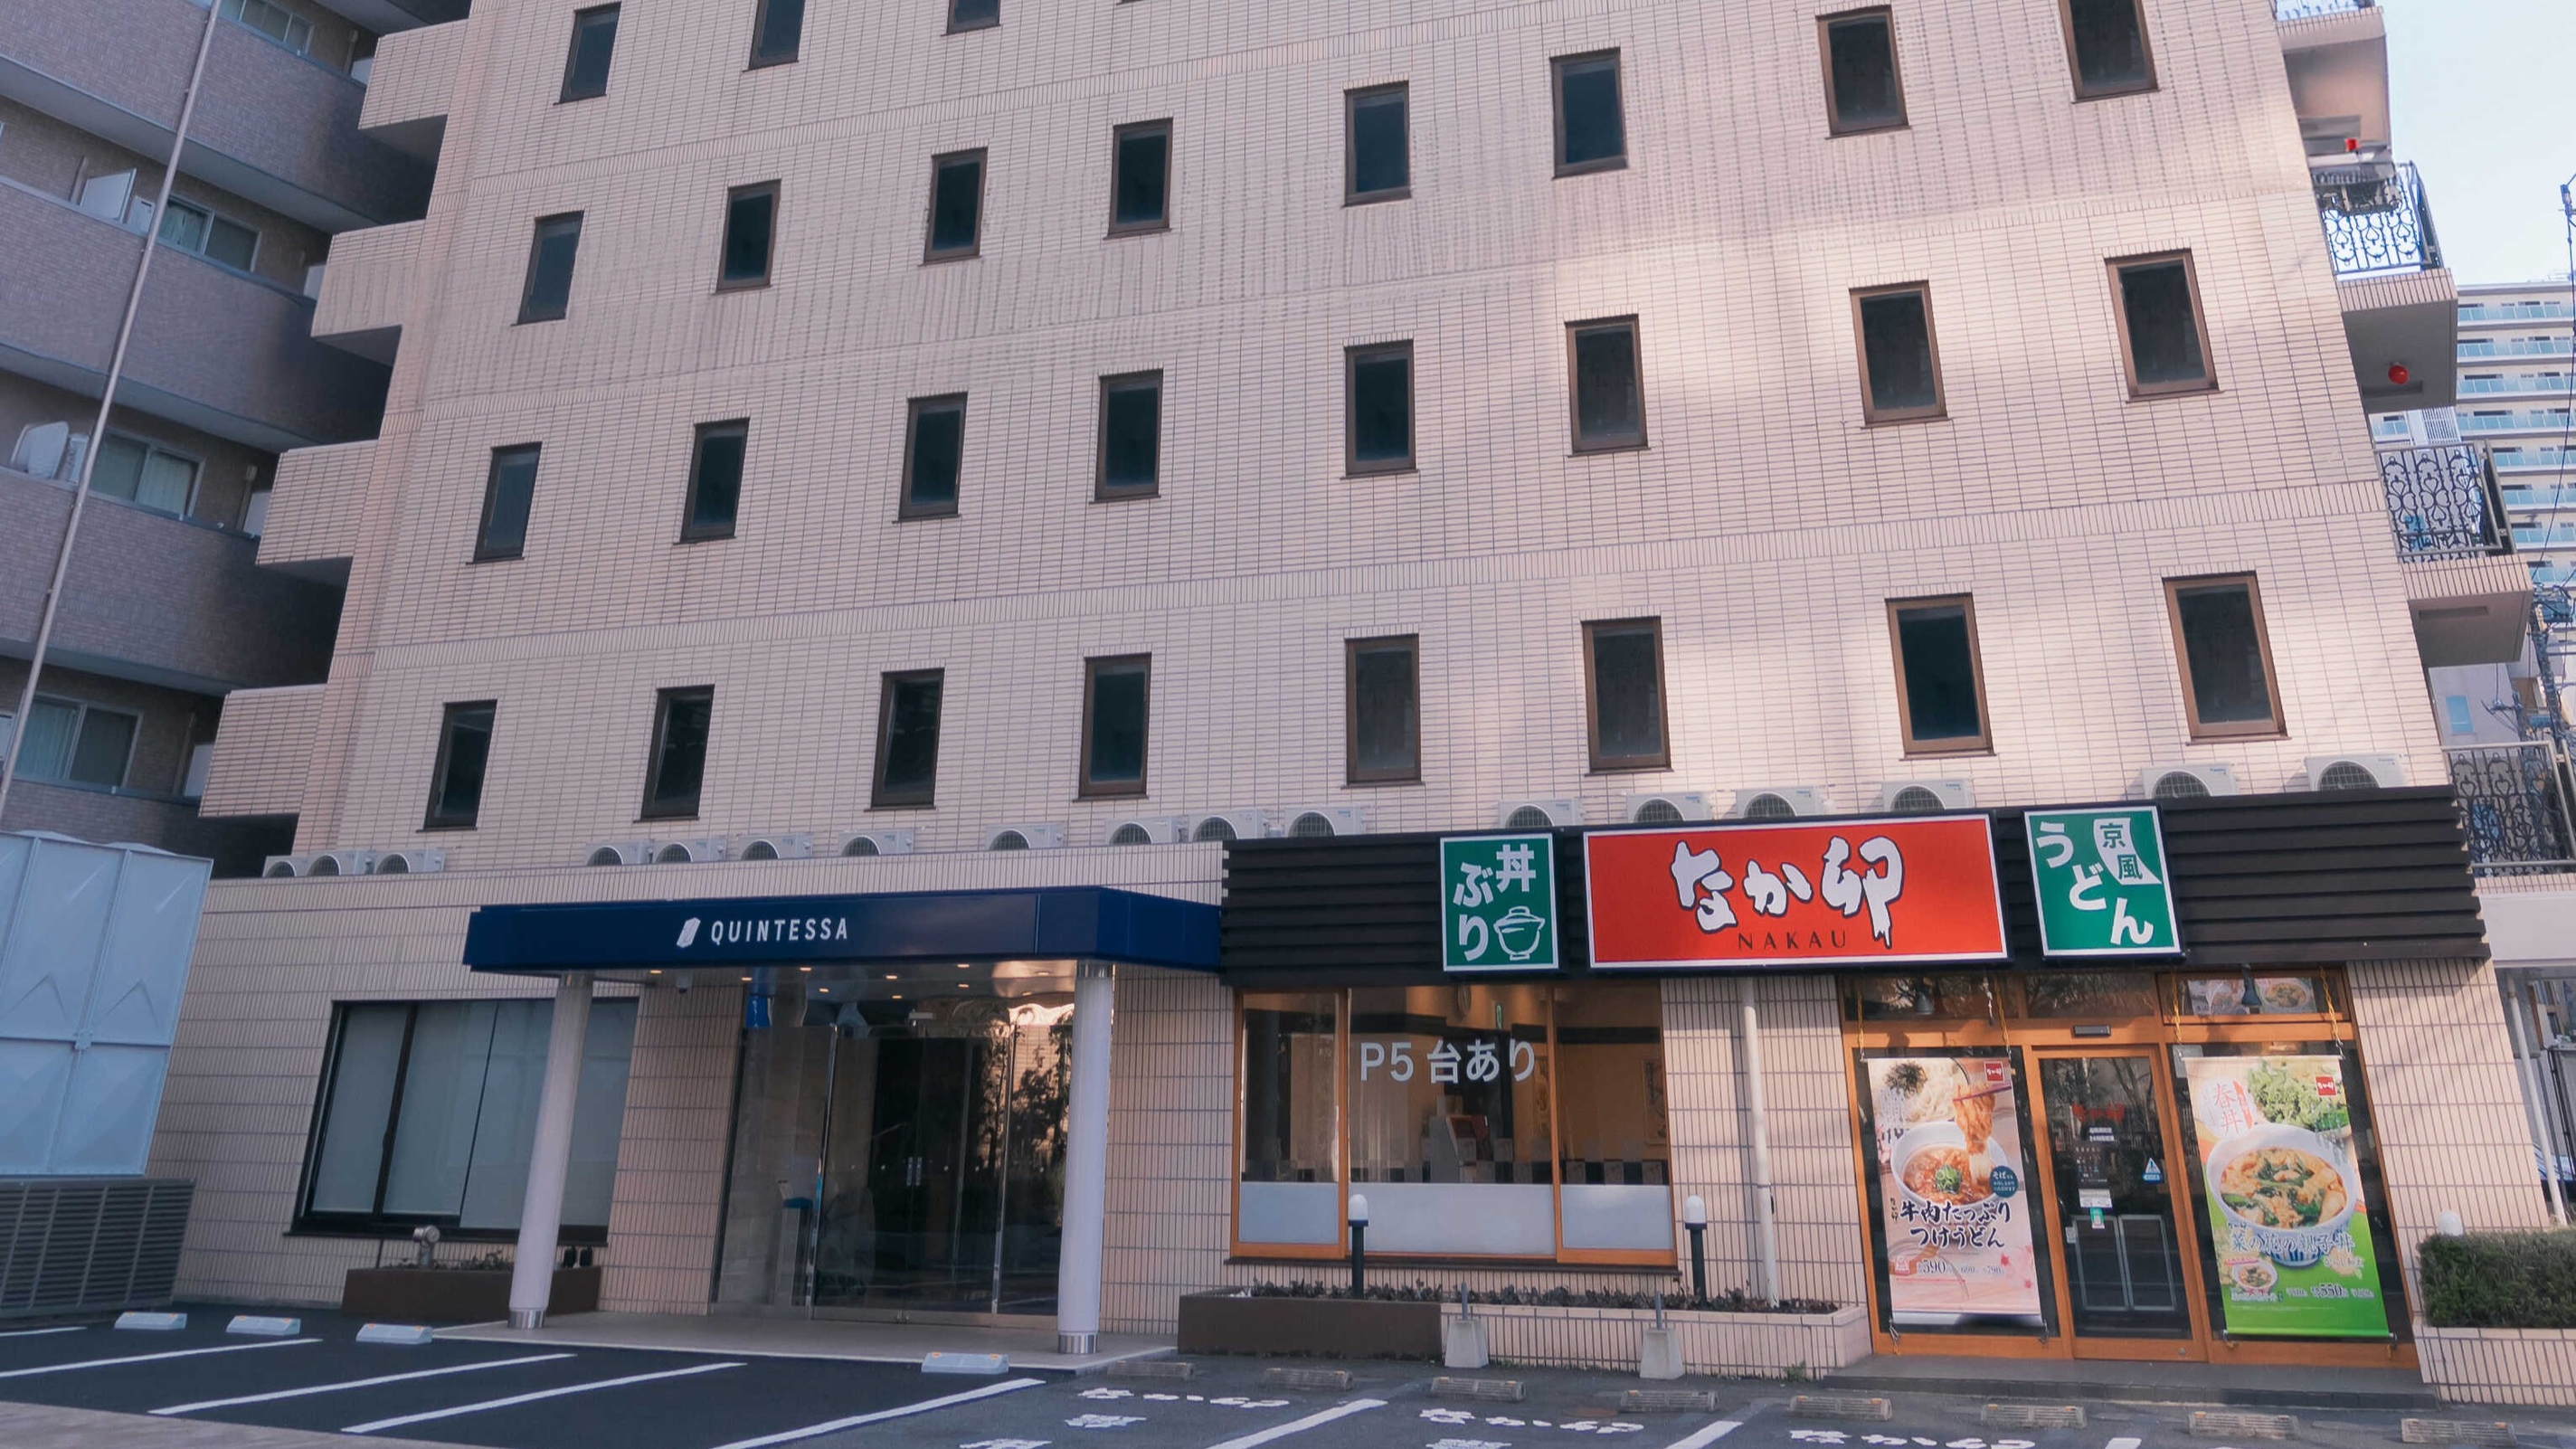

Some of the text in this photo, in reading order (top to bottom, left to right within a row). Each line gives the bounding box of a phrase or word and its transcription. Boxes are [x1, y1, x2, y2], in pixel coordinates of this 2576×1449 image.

[2099, 822, 2143, 880] 京風
[1670, 835, 1904, 950] なか卯
[2036, 820, 2154, 945] うどん
[710, 917, 848, 946] QUINTESSA
[1738, 931, 1846, 951] NAKAU
[1909, 1226, 2005, 1247] つけうどん
